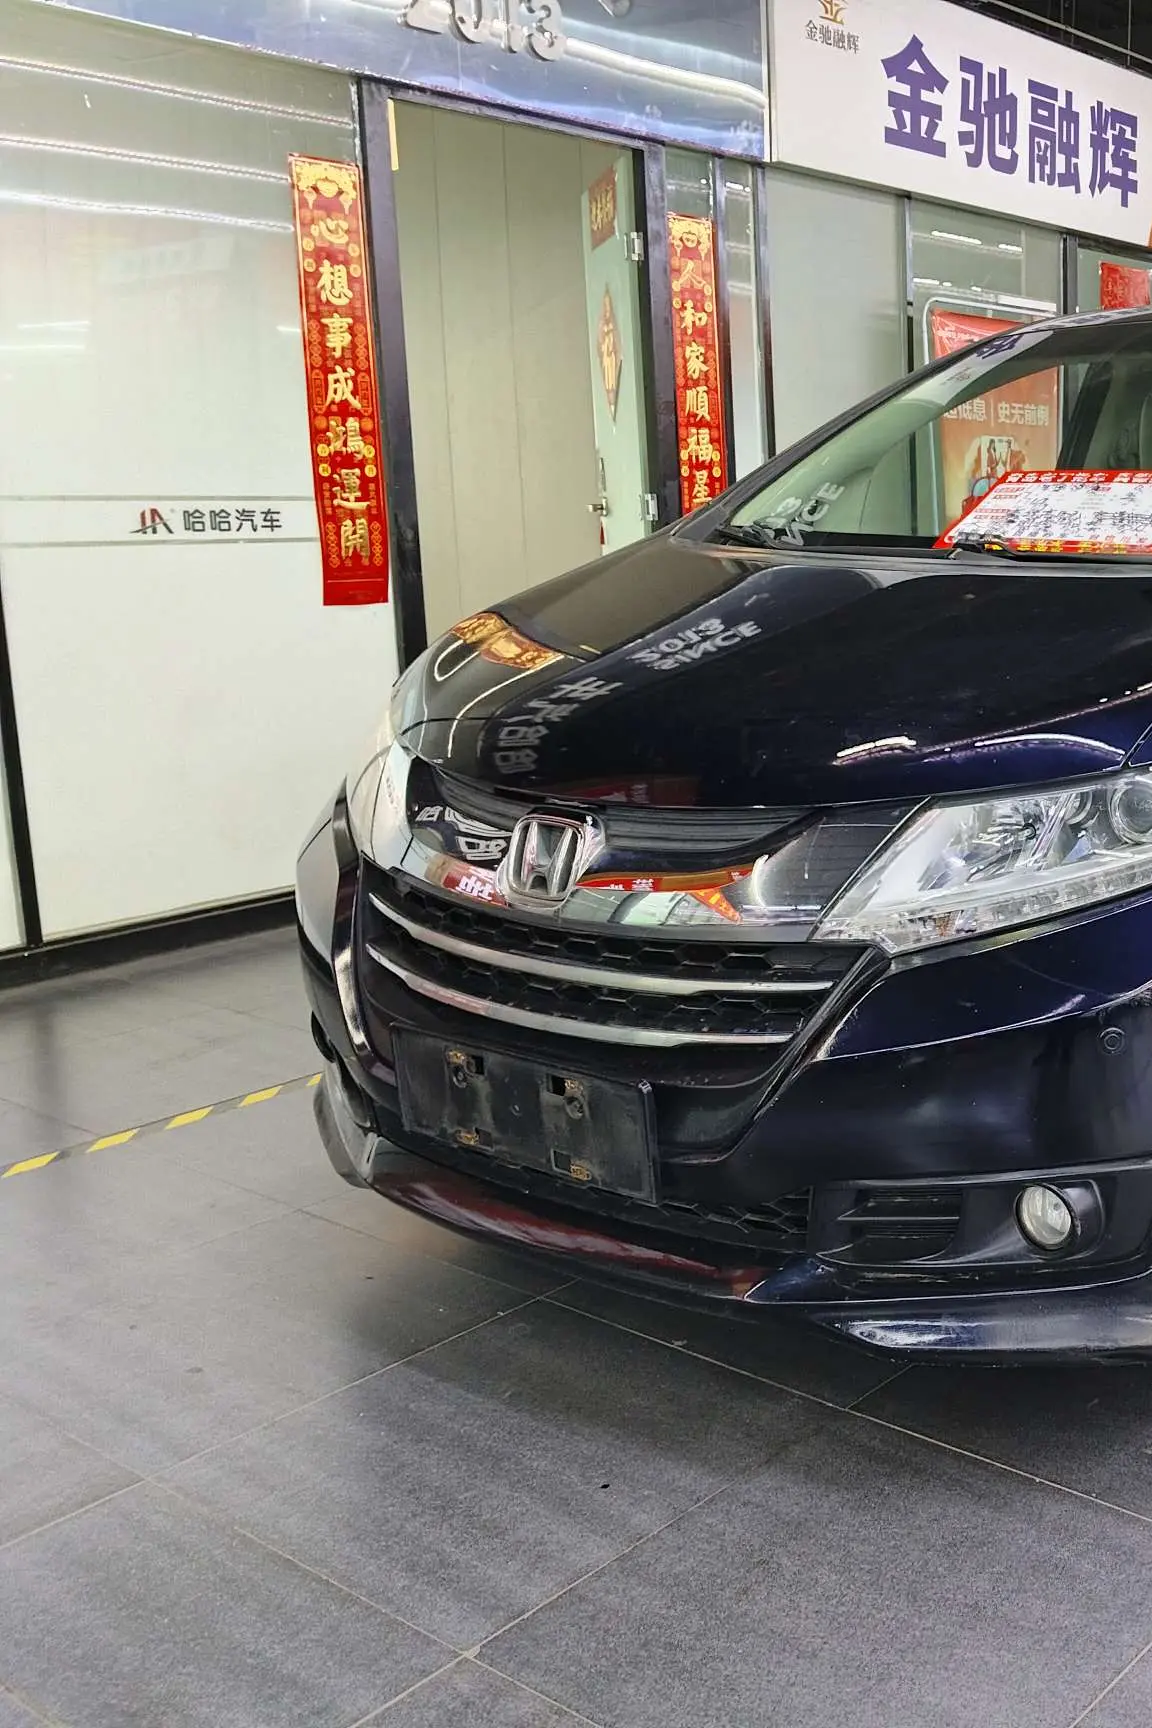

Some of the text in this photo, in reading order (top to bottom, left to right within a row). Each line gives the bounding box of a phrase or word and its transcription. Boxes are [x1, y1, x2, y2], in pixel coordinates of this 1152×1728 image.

[804, 19, 860, 54] 金驰融辉
[881, 34, 1139, 208] 金驰融辉
[183, 508, 282, 532] 哈哈汽车
